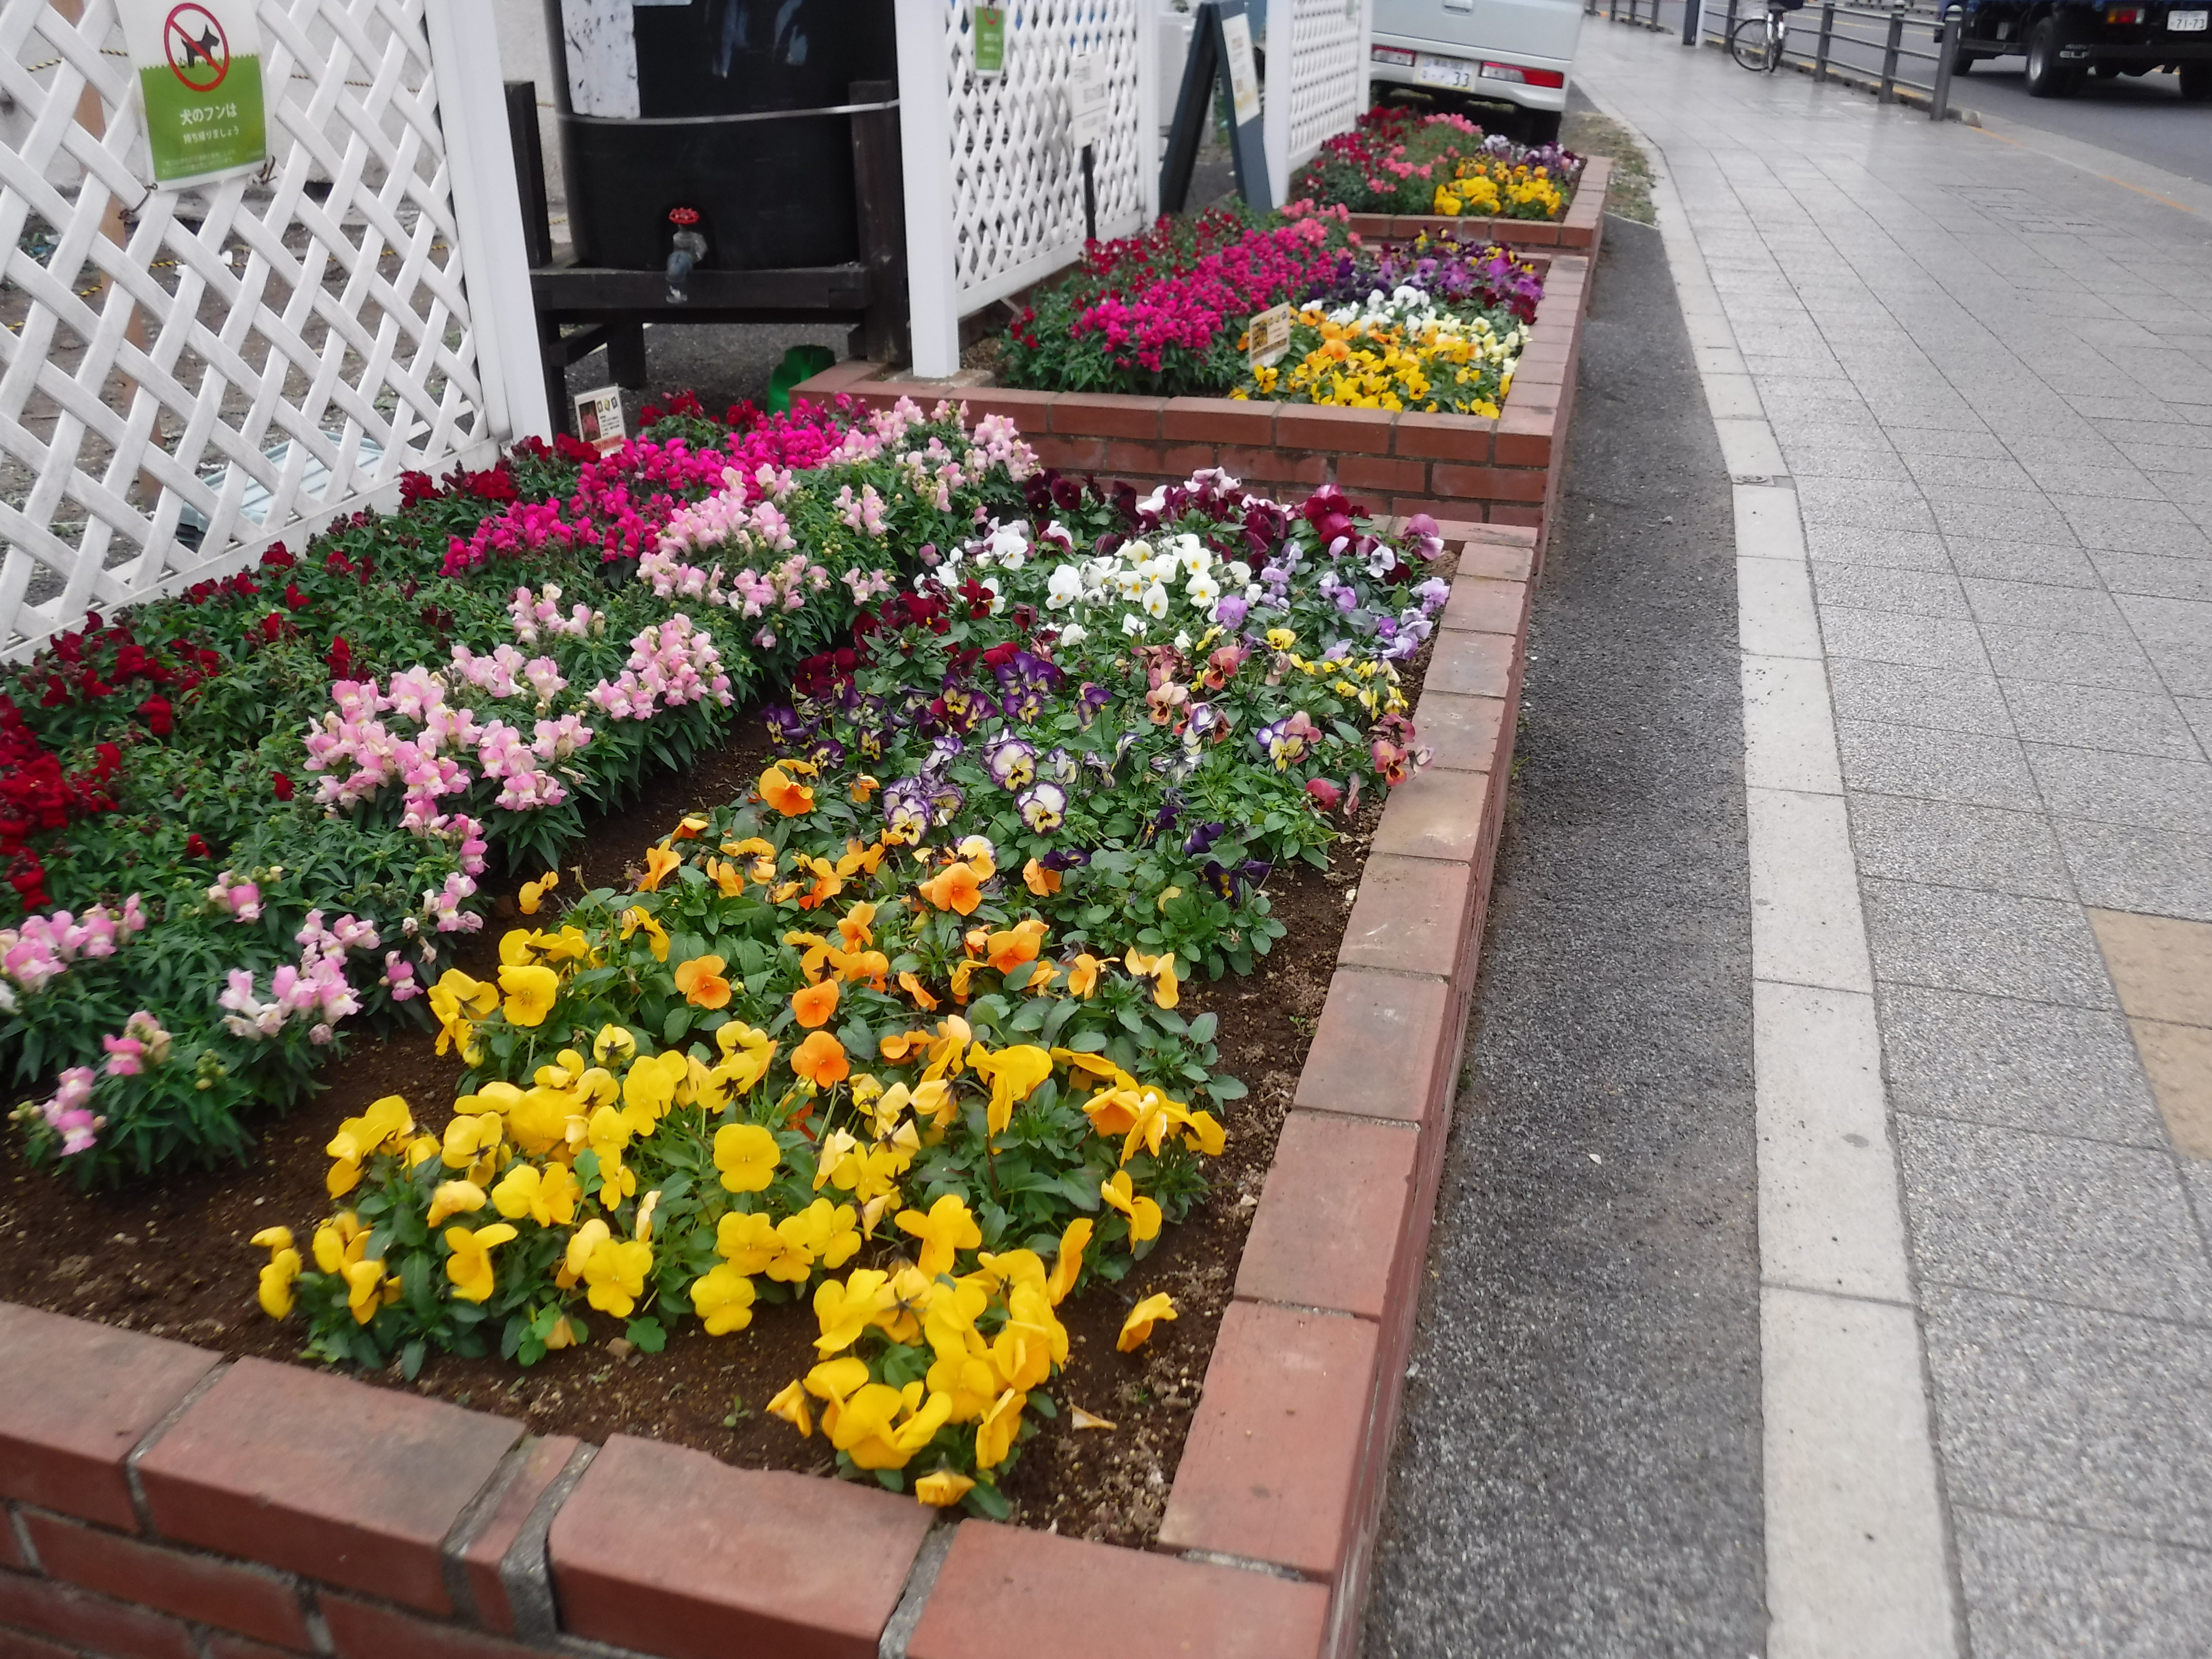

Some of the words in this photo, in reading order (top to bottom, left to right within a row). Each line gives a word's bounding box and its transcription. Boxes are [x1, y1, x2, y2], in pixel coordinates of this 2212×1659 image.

[180, 102, 237, 126] 犬のフンは
